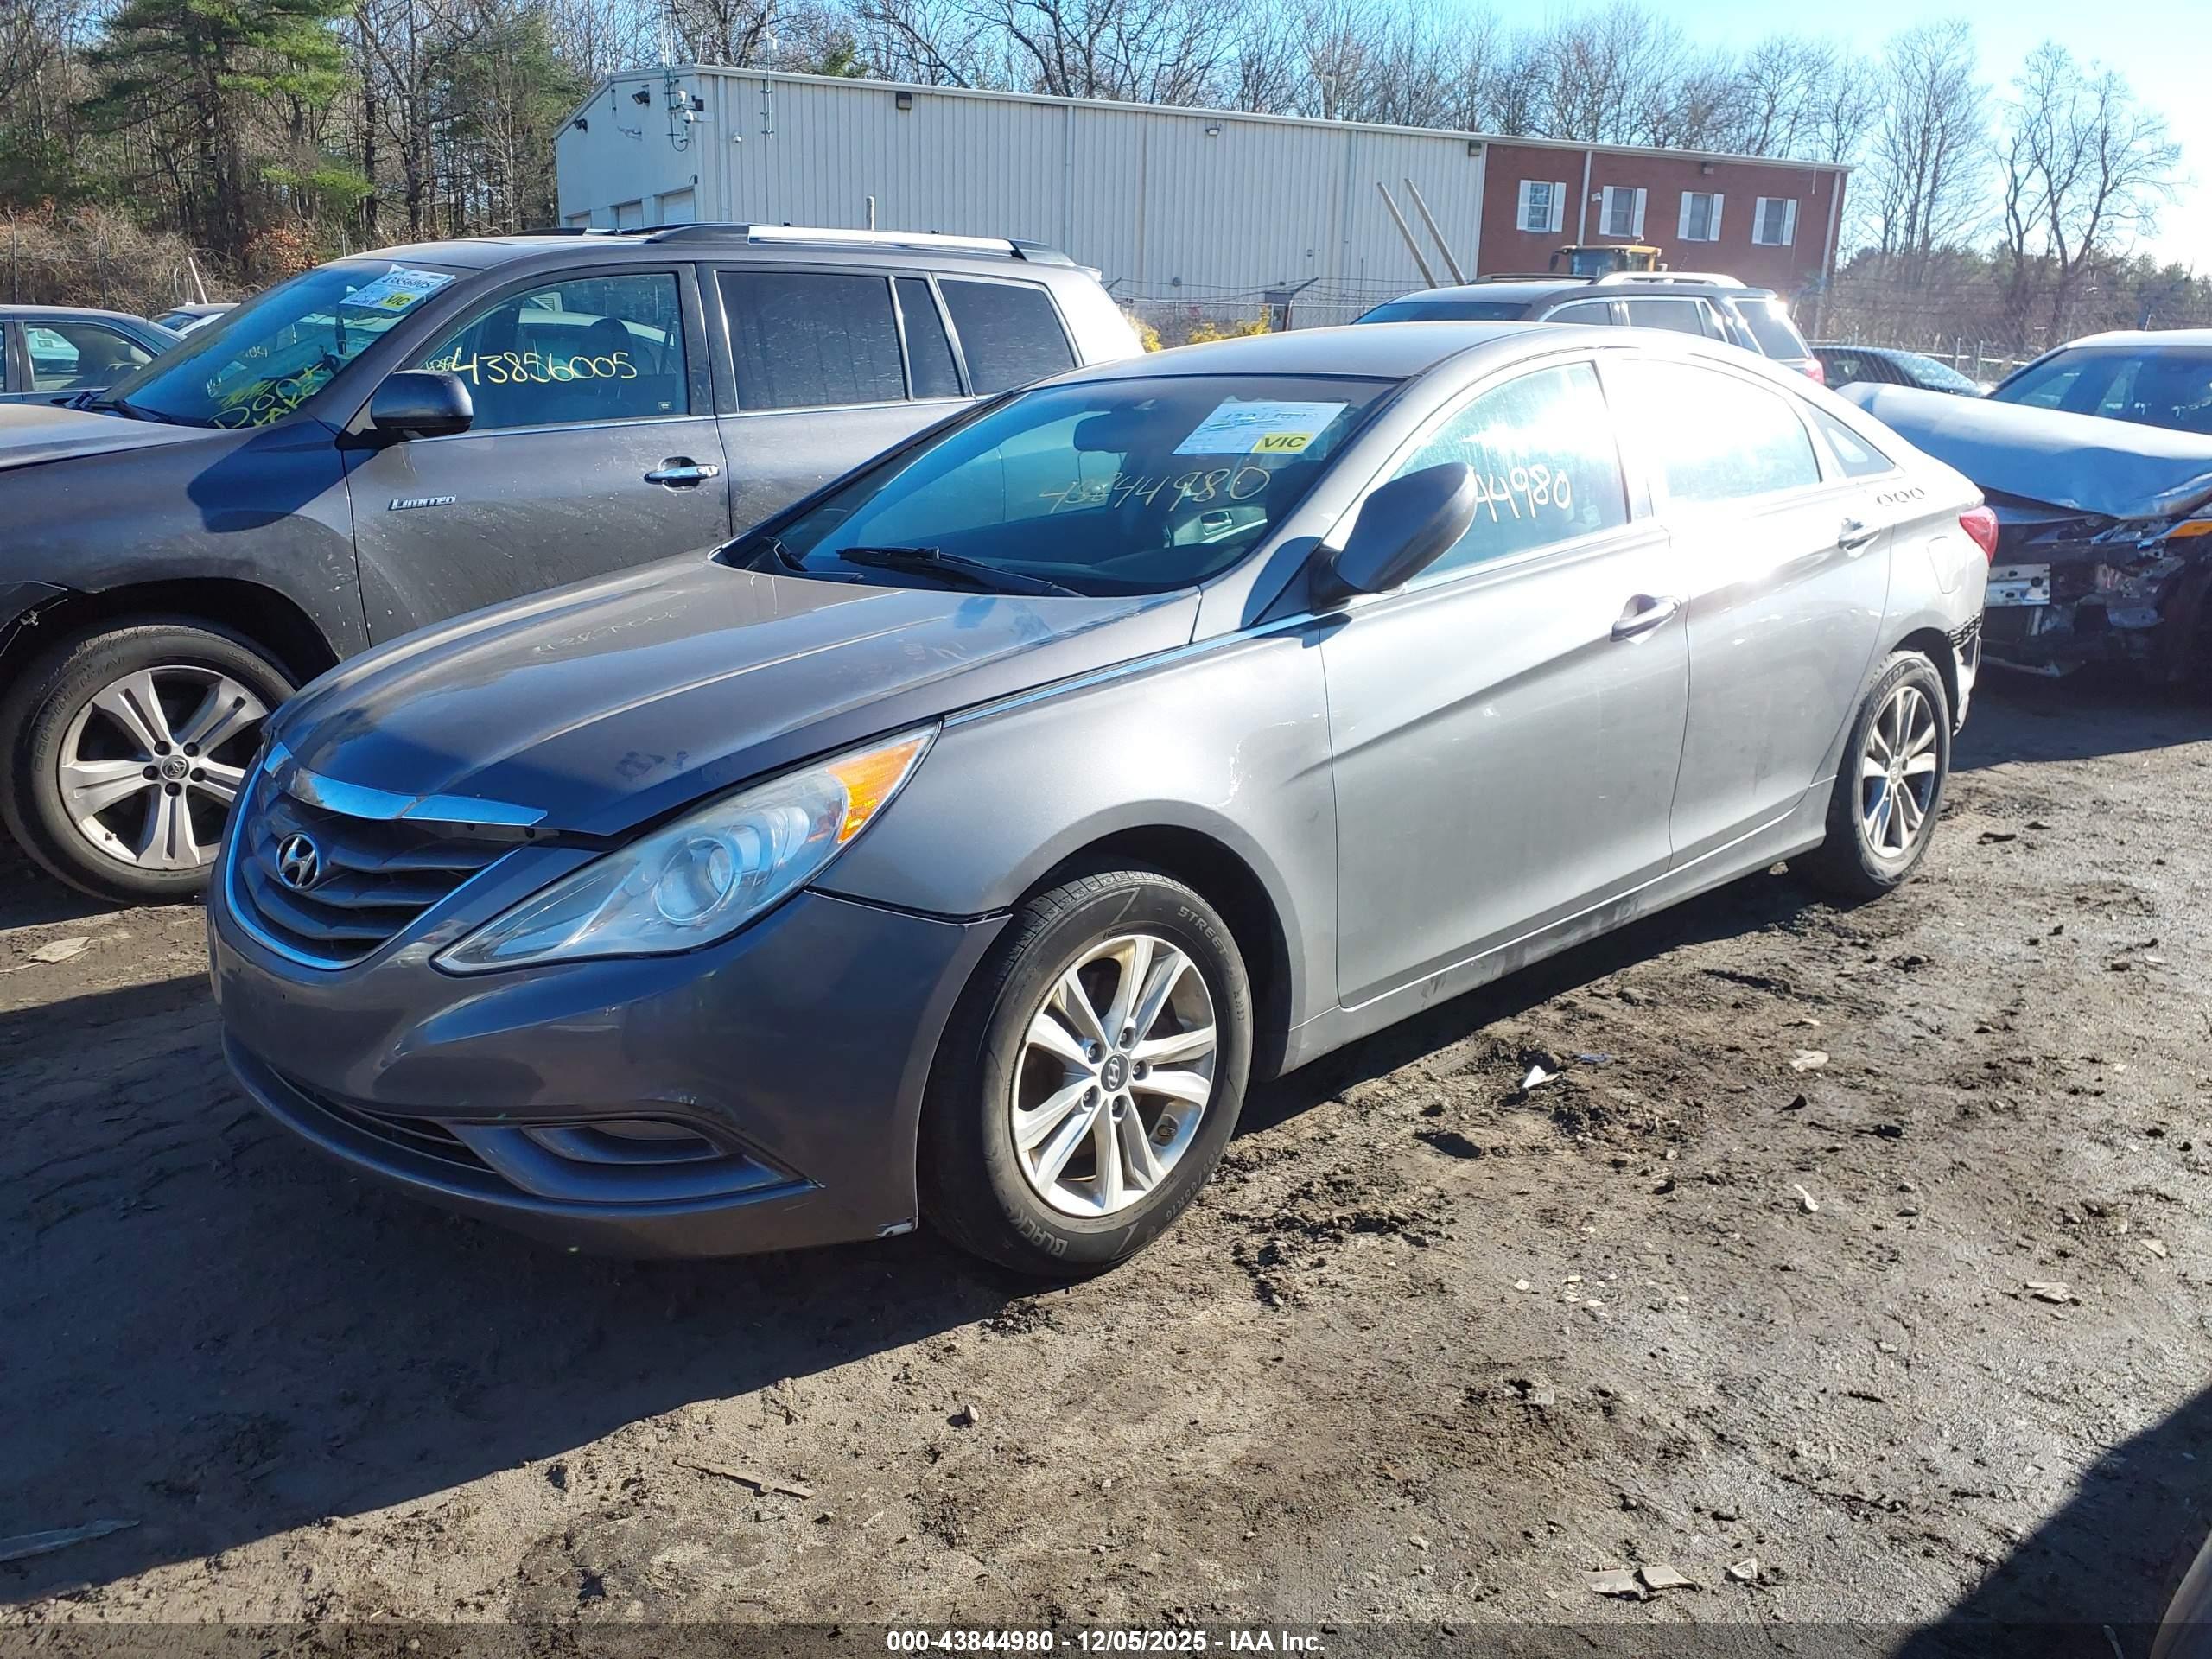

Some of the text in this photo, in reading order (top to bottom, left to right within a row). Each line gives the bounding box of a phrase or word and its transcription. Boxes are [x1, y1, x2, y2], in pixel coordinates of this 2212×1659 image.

[385, 295, 410, 306] VIC
[452, 346, 637, 385] 43856005
[1263, 436, 1306, 448] VIC
[1039, 466, 1271, 513] 43844980
